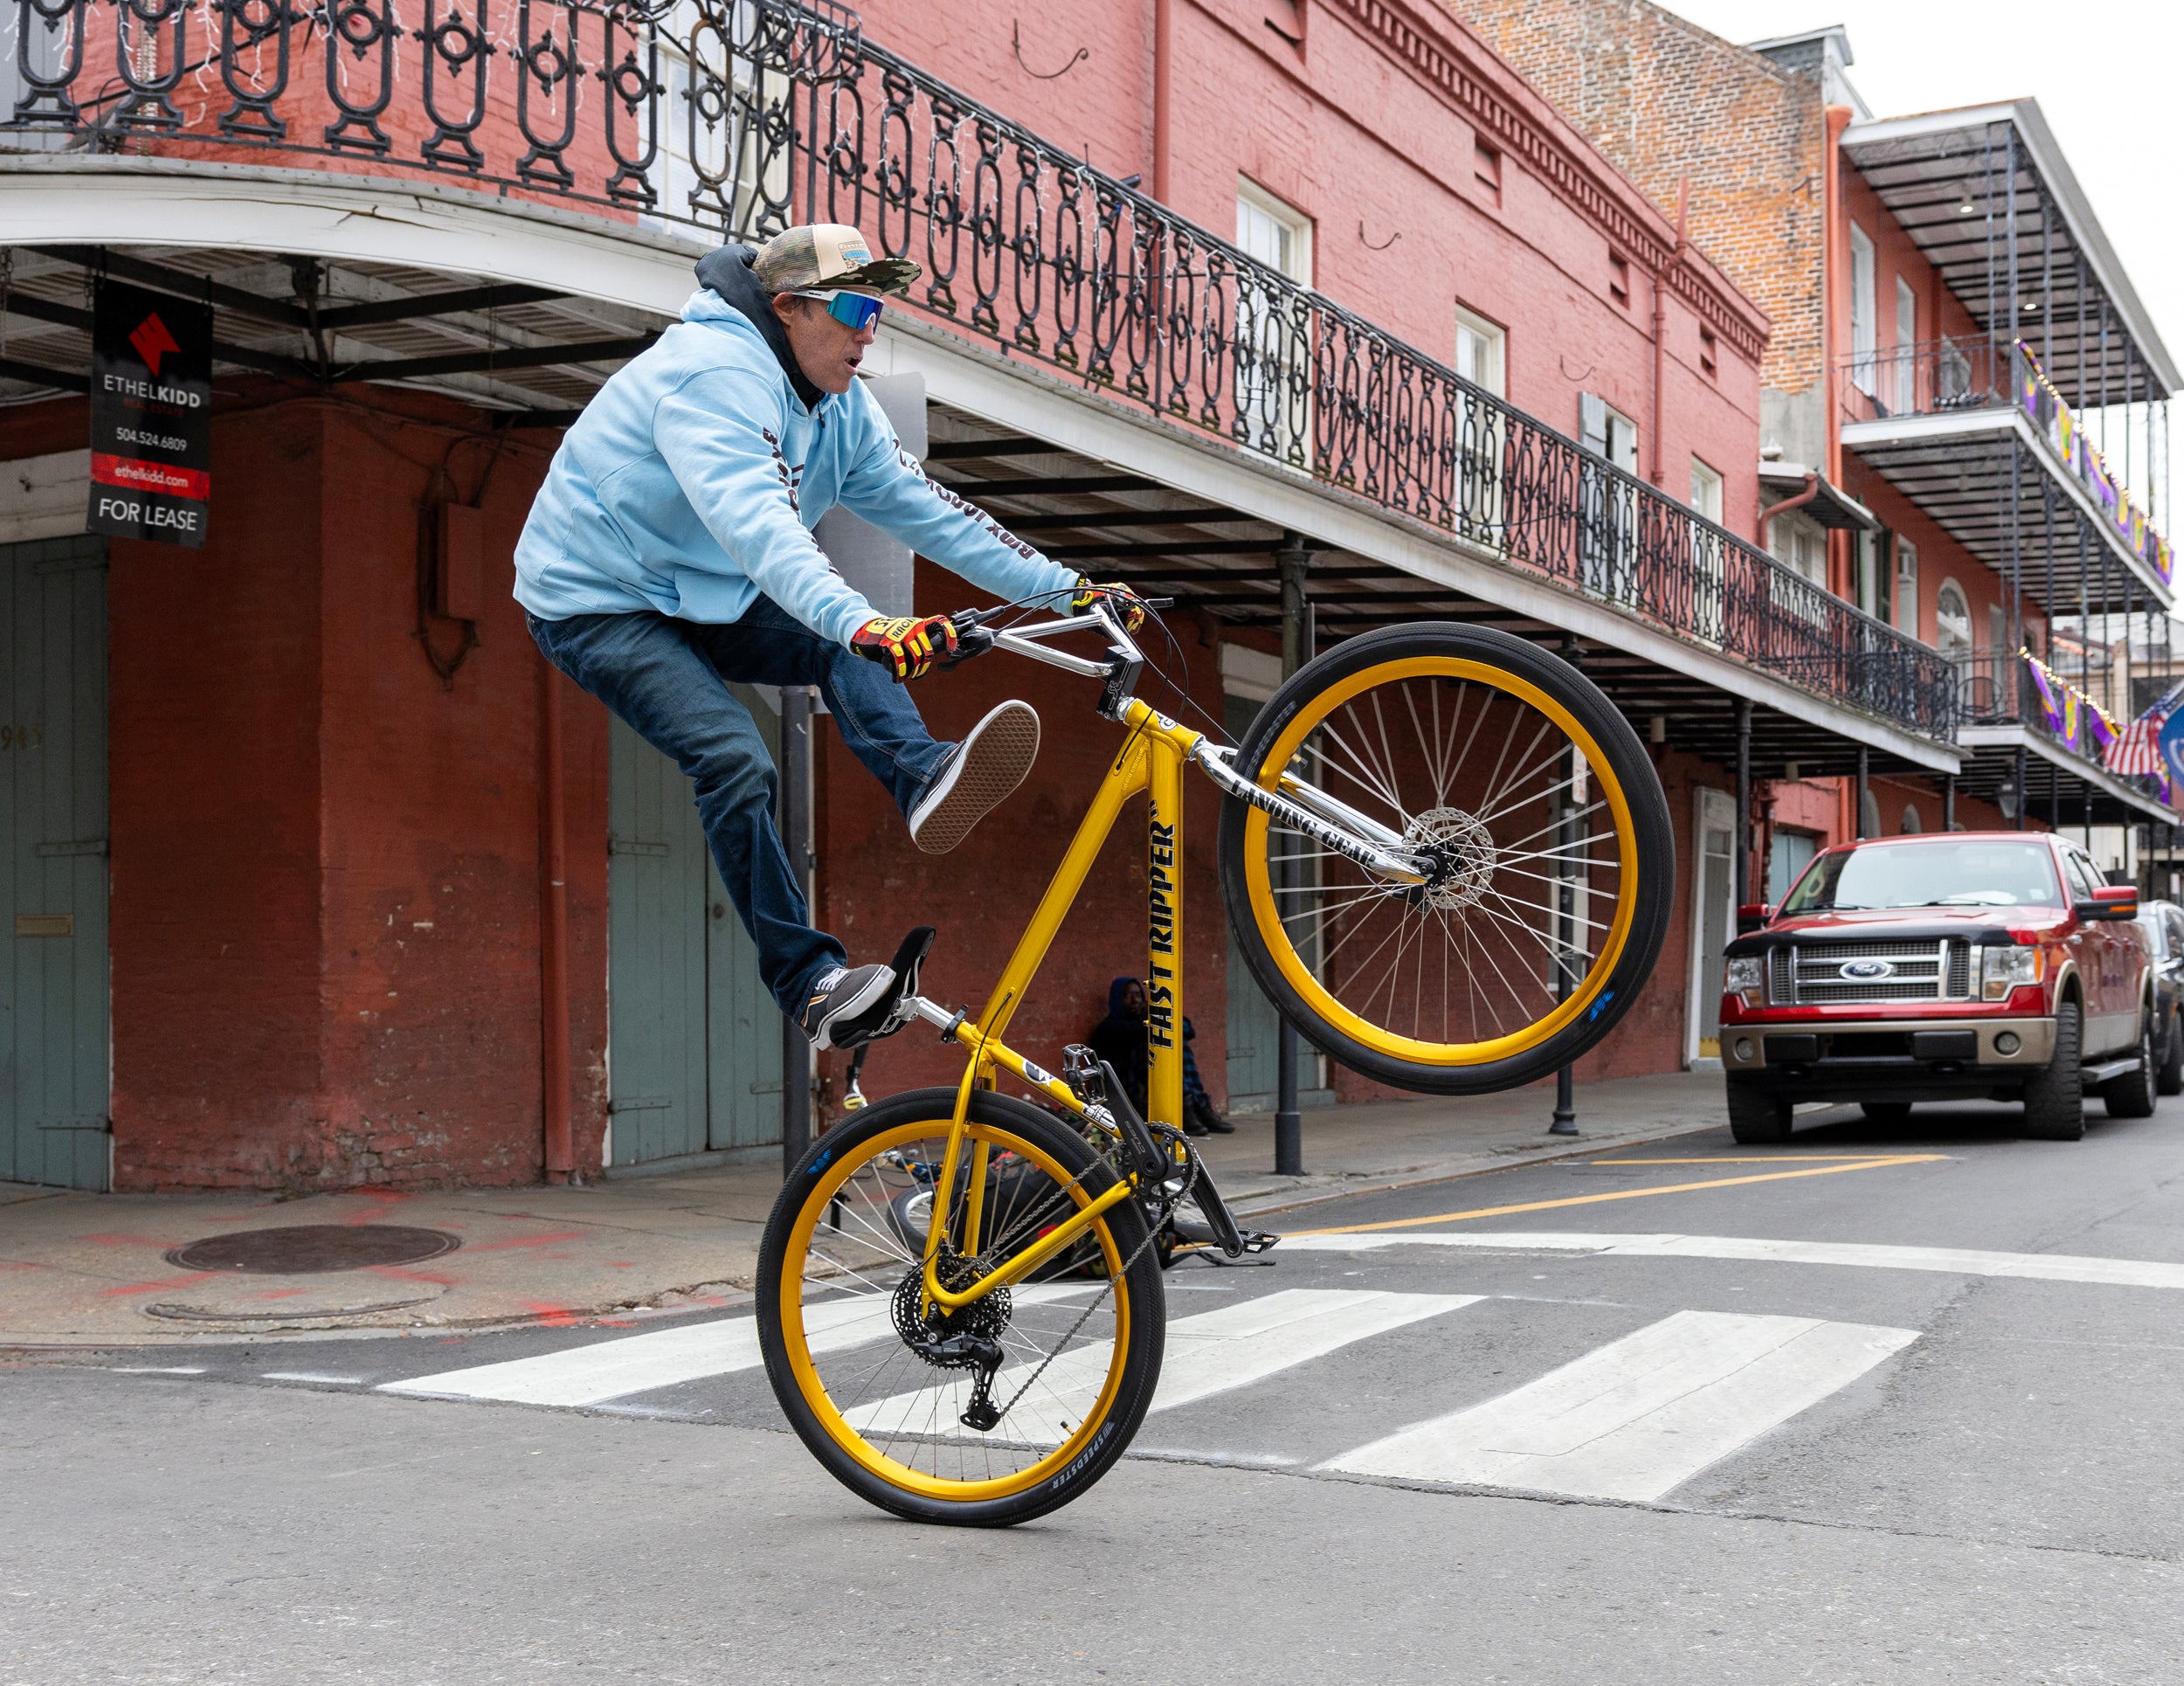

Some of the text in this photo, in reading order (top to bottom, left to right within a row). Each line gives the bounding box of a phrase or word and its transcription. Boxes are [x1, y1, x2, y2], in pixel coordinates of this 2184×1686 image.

[103, 373, 201, 408] ETHELKIDD
[116, 426, 188, 452] 504.524.6809
[114, 465, 189, 488] ethelkidd.com
[99, 498, 198, 531] FOR LEASE
[1231, 779, 1377, 868] LANDING GEAR
[1053, 1434, 1104, 1489] SPEEDSTER
